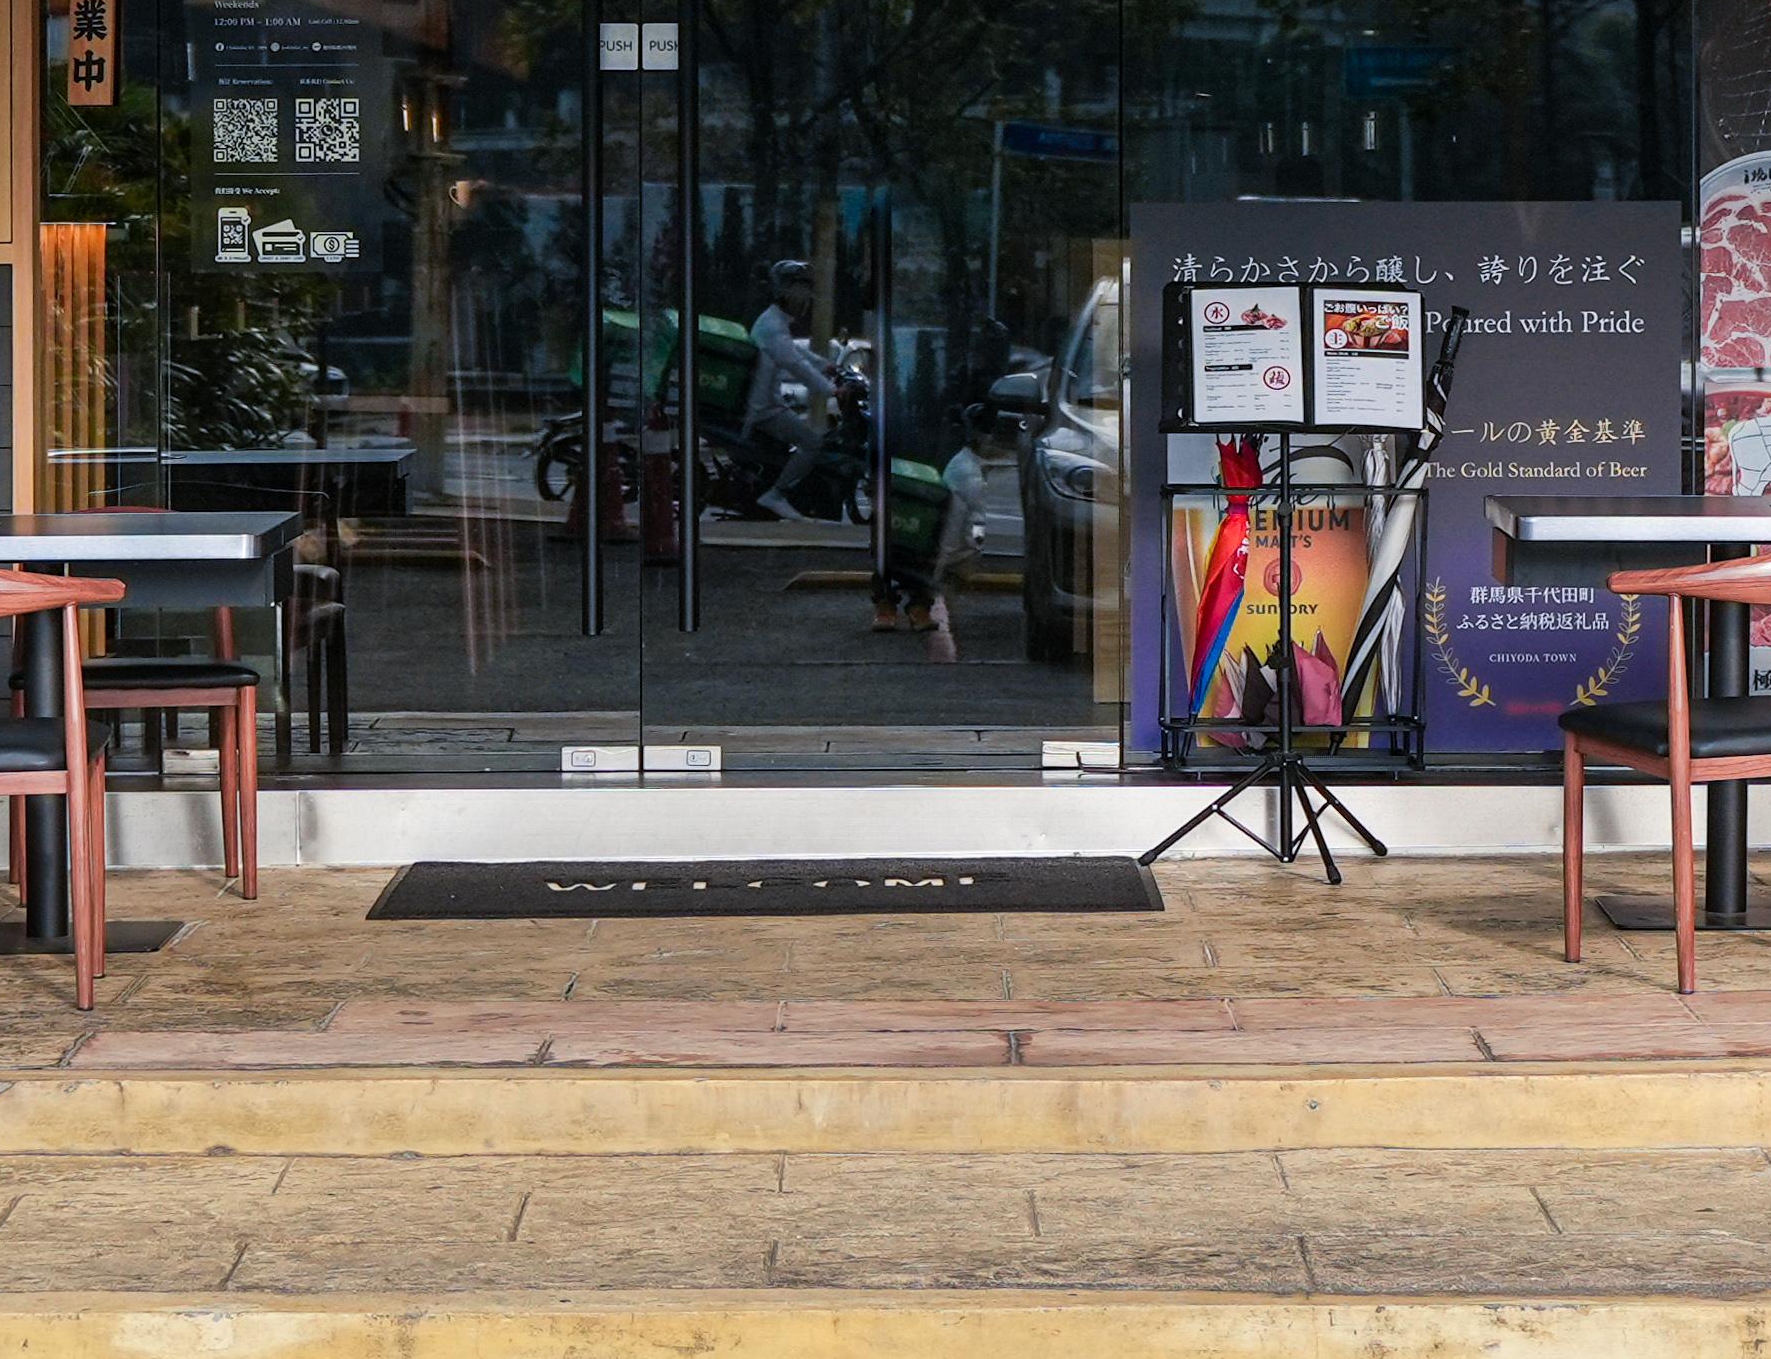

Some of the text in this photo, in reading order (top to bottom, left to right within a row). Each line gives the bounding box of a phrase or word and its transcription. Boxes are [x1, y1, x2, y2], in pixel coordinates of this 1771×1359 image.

[215, 1, 259, 9] Weekends
[1519, 311, 1572, 334] with
[1581, 311, 1644, 334] Pride
[1451, 418, 1646, 446] ールの黄金基準
[1427, 462, 1647, 478] The Gold Standard of Beer
[1256, 536, 1312, 548] MAT'S
[1470, 587, 1594, 604] 群馬県千代田町
[1456, 613, 1609, 630] ふるさと納税返礼品
[1489, 654, 1577, 662] CHIYODA TOWN
